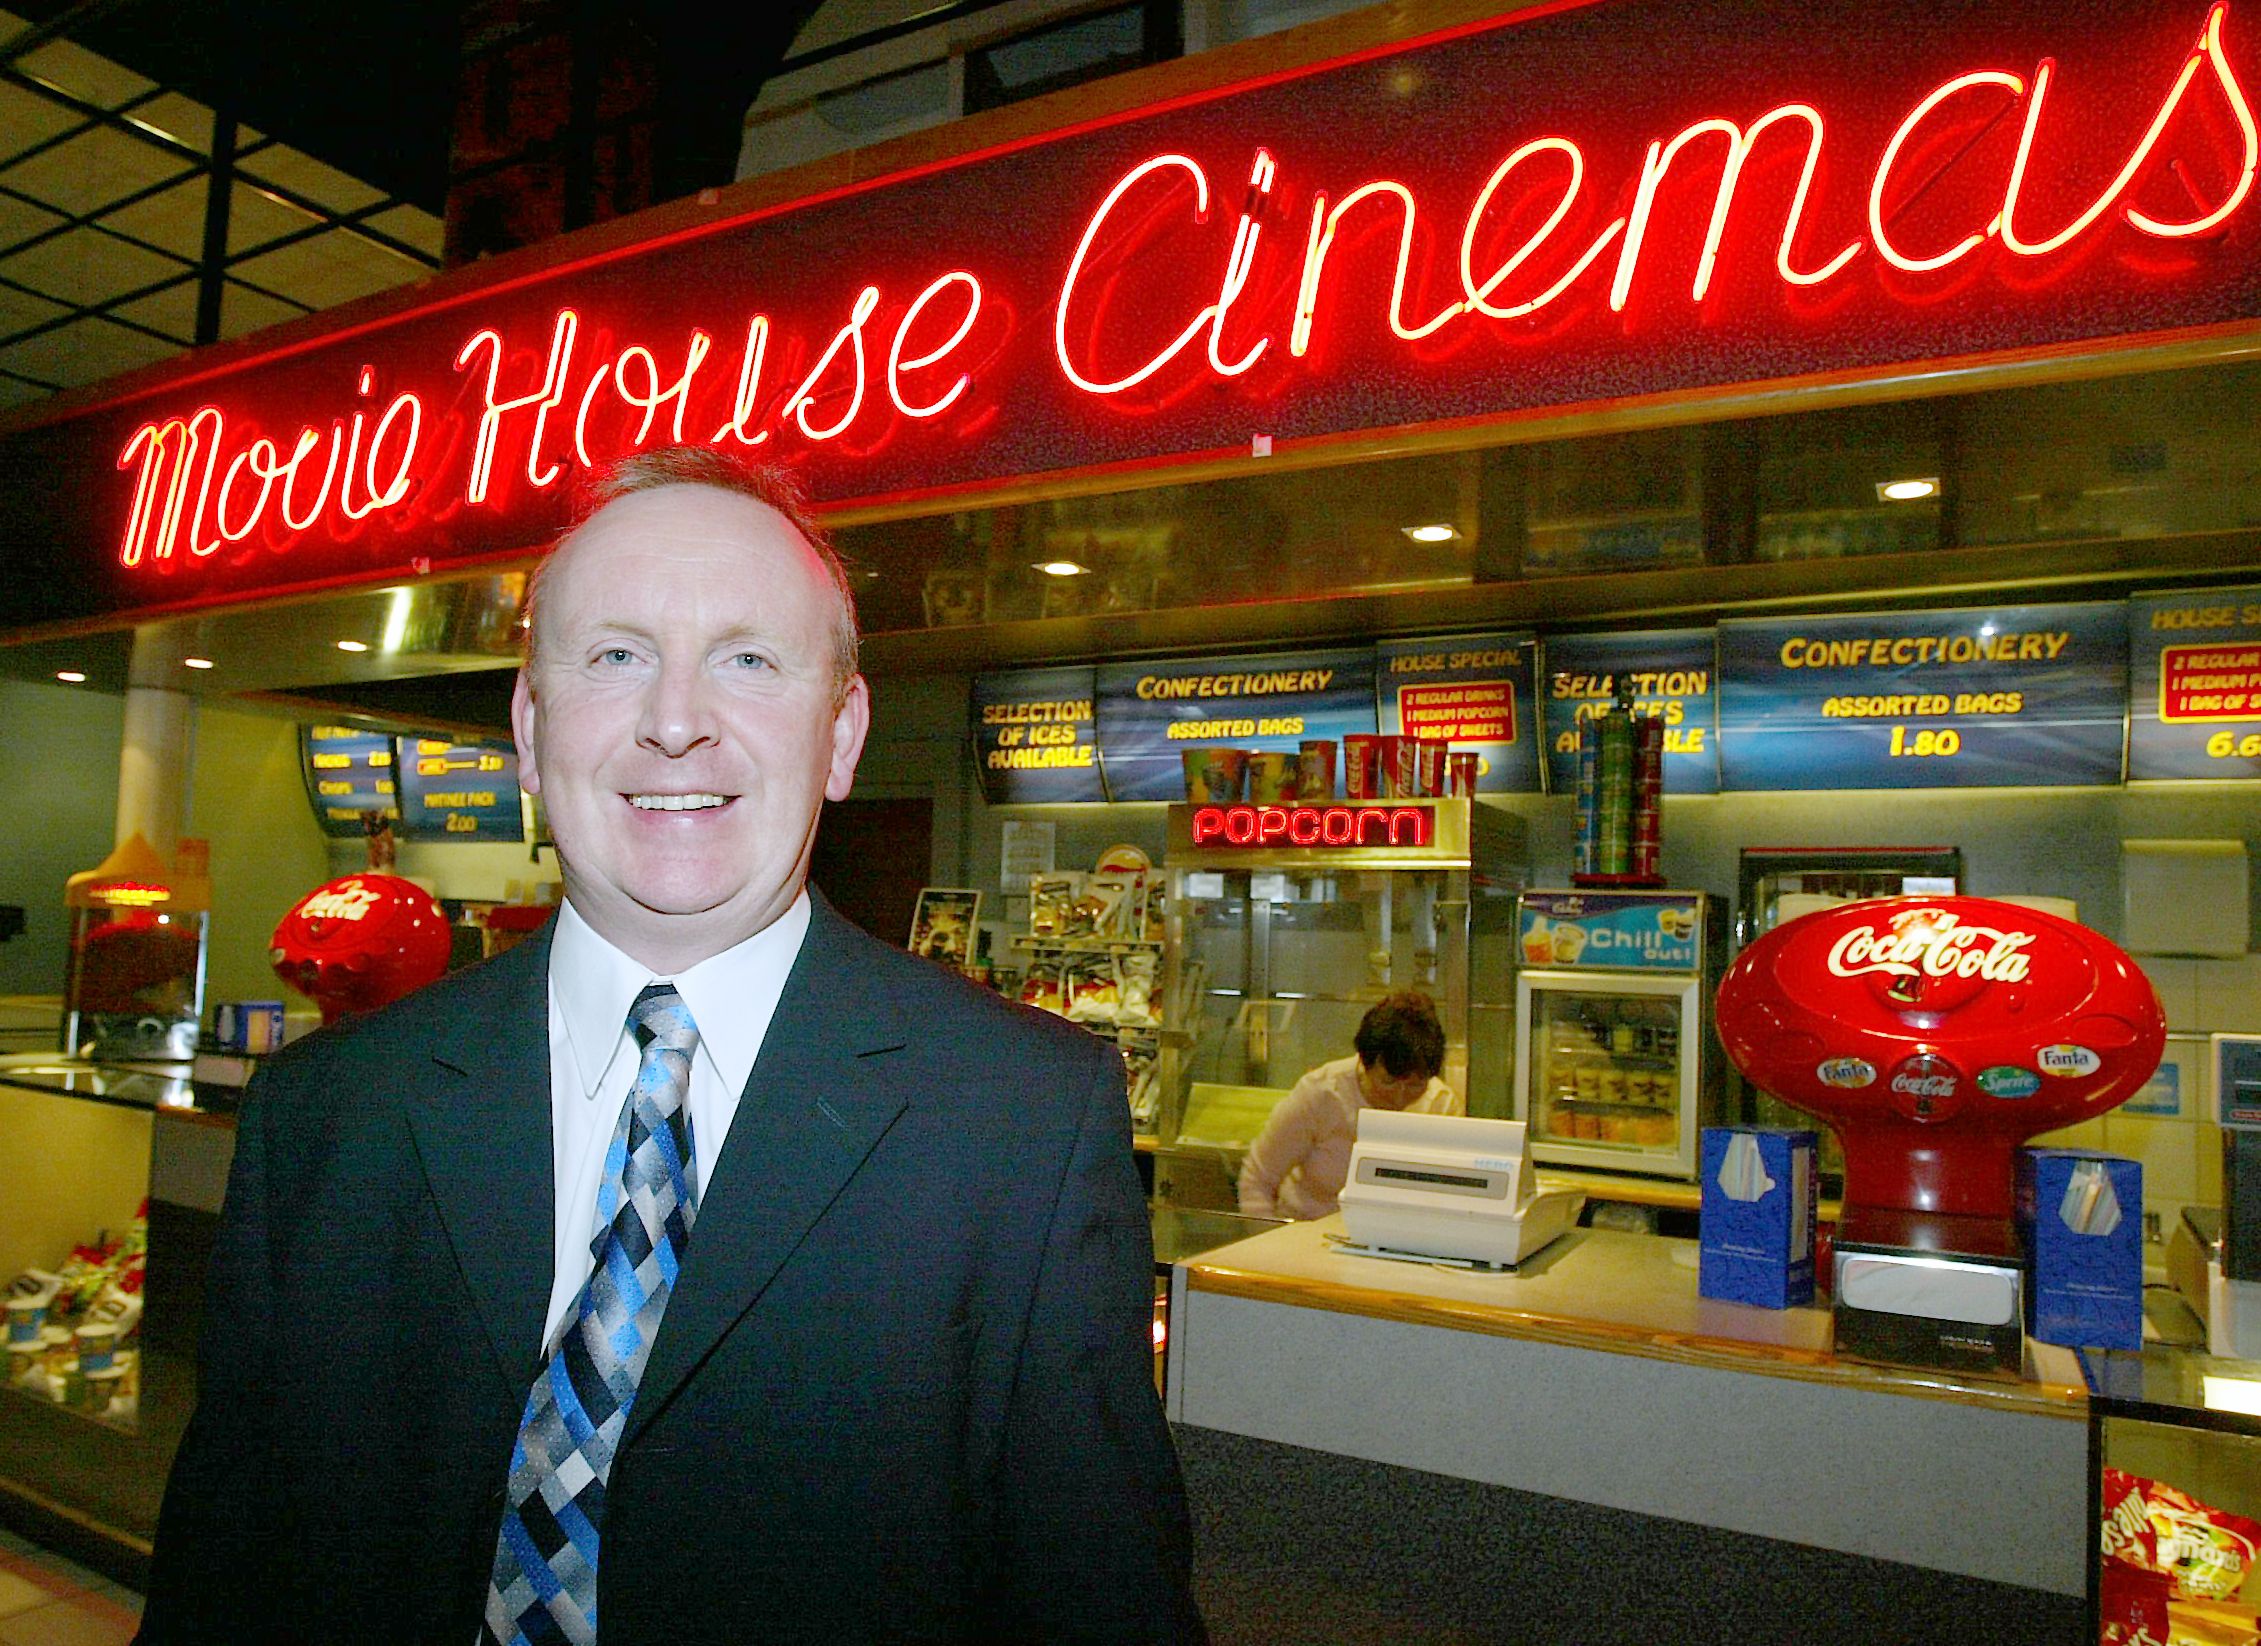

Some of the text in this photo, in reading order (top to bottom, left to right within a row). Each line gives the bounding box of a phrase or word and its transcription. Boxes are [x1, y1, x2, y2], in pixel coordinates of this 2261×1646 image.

[118, 2, 2260, 569] Movie House Cinemas
[2152, 606, 2237, 630] HOUSE
[1390, 650, 1522, 673] HOUSE SPECIAL
[1780, 631, 2070, 669] CONFECTIONERY
[1136, 670, 1334, 699] CONFECTIONERY
[1552, 672, 1708, 698] SELETION
[2181, 674, 2247, 690] MEDIUM
[981, 699, 1092, 724] SELECTION
[1457, 706, 1509, 720] POPCORN
[1821, 693, 2023, 718] ASSORTED BAGS
[2189, 694, 2223, 711] BAG
[2223, 694, 2248, 710] OF
[998, 724, 1077, 746] OF ICES
[1166, 717, 1305, 740] ASSORTED BAGS
[1889, 727, 1961, 757] 1.80
[987, 745, 1094, 769] AVAILABLE
[1589, 928, 1662, 949] Chill
[2043, 1050, 2090, 1067] Fanta
[1823, 1063, 1870, 1081] Fanta
[1982, 1073, 2033, 1092] Sprite
